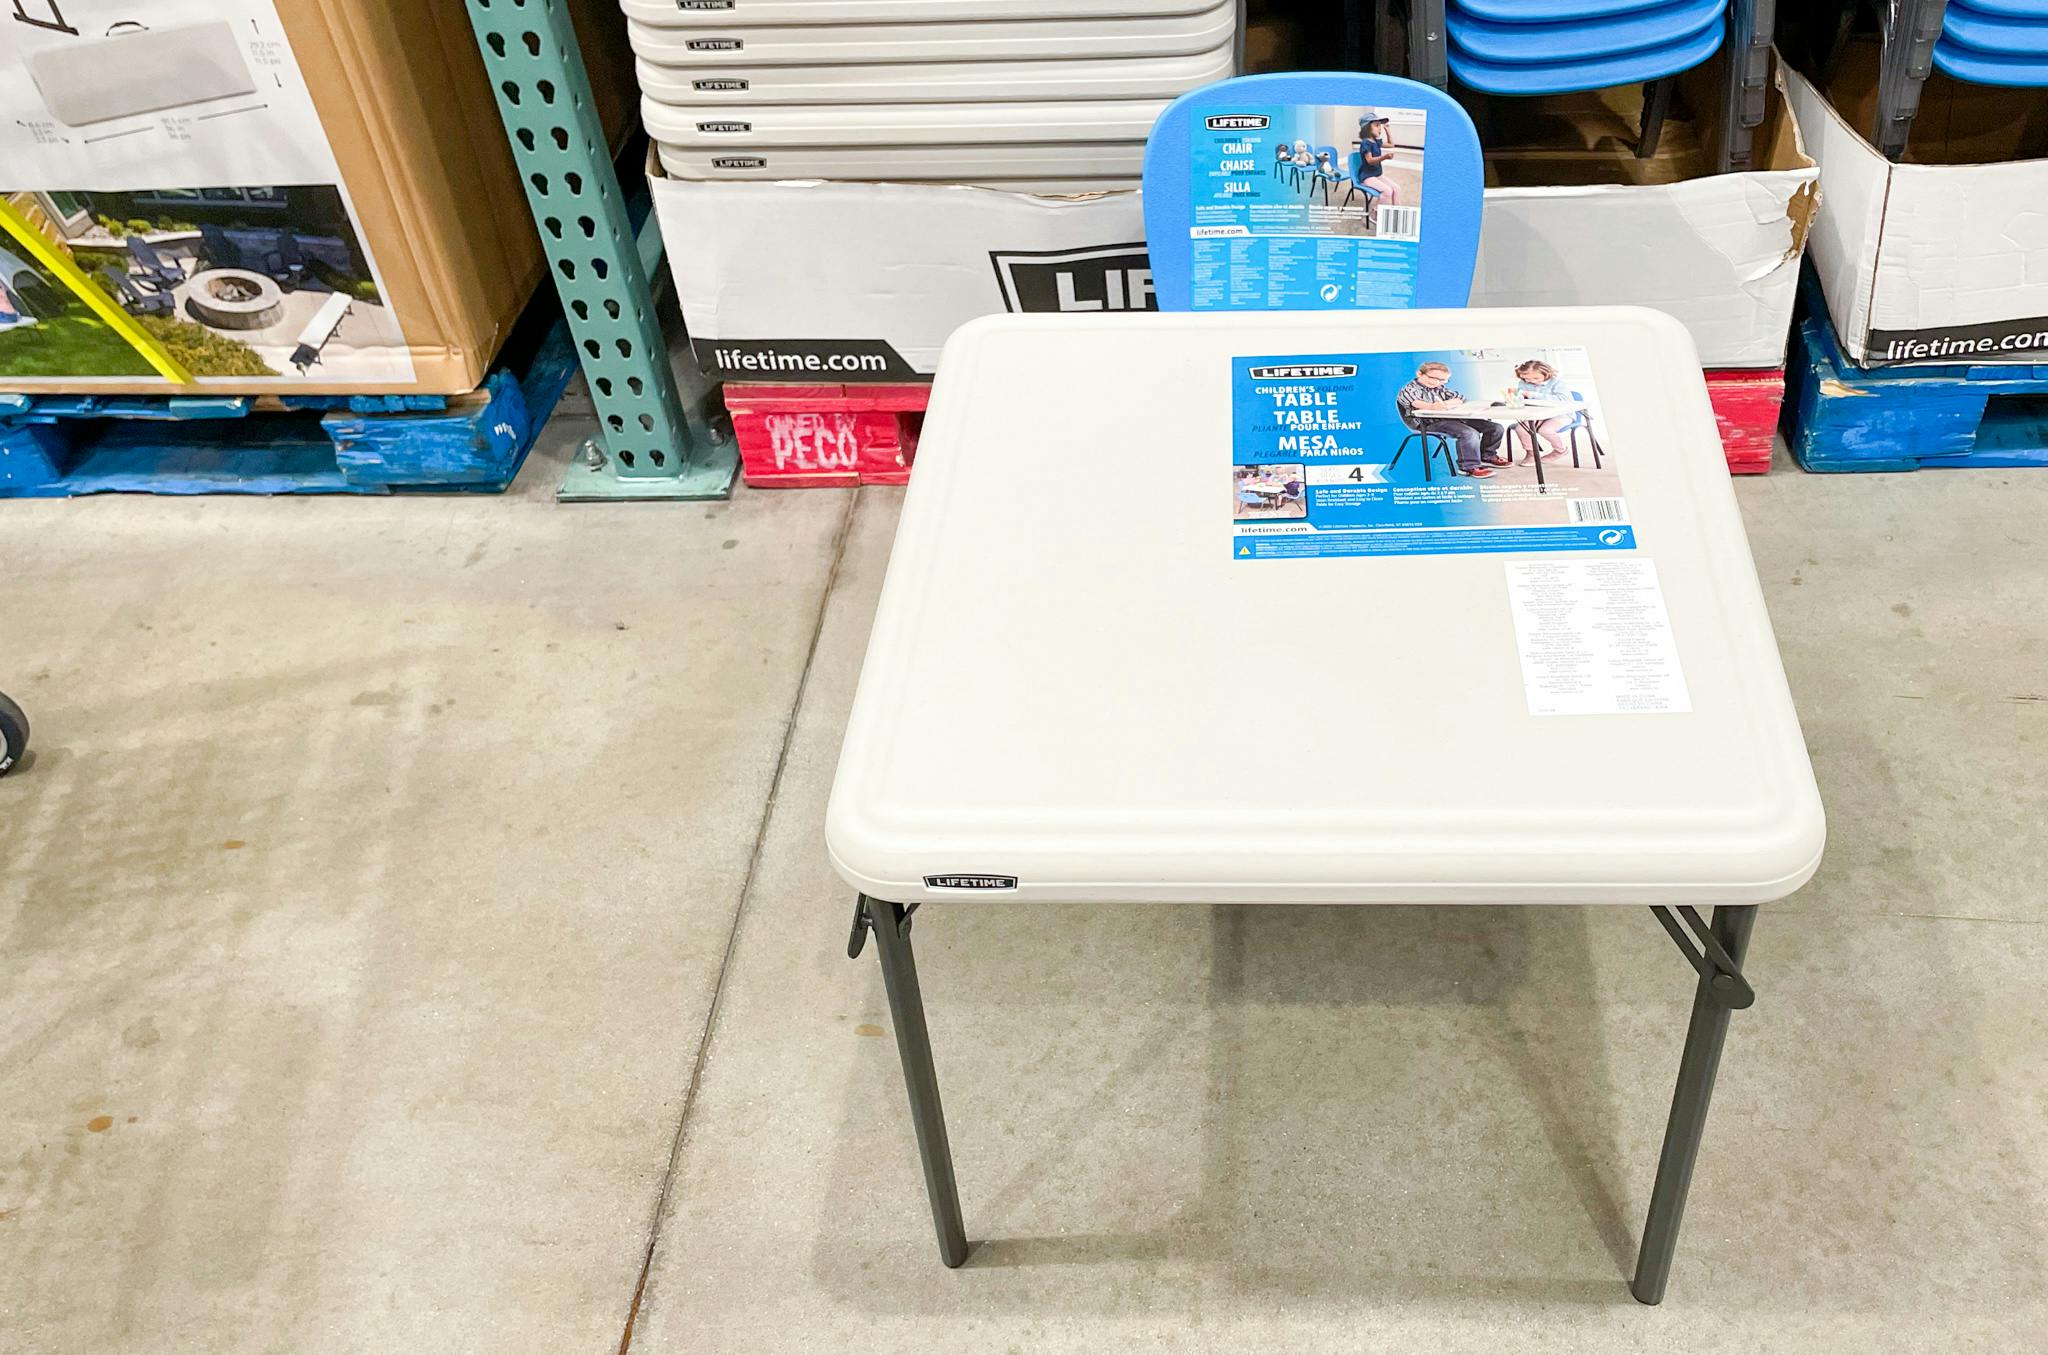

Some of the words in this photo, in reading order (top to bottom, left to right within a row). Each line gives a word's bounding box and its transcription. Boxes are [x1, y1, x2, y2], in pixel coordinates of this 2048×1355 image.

[693, 41, 736, 50] LIFETIME
[700, 82, 742, 90] LIFETIME
[704, 124, 745, 132] LIFETIME
[1212, 118, 1263, 127] LIFETIME
[1222, 143, 1253, 155] CHAIR
[720, 160, 760, 168] LIFETIME
[1220, 160, 1255, 171] CHAISE
[1223, 181, 1251, 193] SILLA
[1196, 228, 1243, 237] lifetime.com
[714, 348, 887, 371] lifetime.com
[1262, 366, 1345, 377] LIFETIME
[1255, 385, 1315, 395] CHILDREN'S
[1316, 384, 1355, 393] FOLDING
[1272, 391, 1338, 407] TABLE
[1273, 409, 1339, 425] TABLE
[1251, 424, 1288, 433] PLIANTE
[1290, 423, 1321, 432] POUR
[1321, 421, 1362, 431] ENFANT
[1278, 434, 1338, 451] MESA
[770, 427, 858, 471] PECO
[1300, 448, 1328, 457] PARA
[1330, 446, 1364, 456] NIÑOS
[1348, 467, 1364, 483] 4
[1240, 525, 1308, 534] lifetime.com
[936, 878, 1006, 887] LIFETIME
